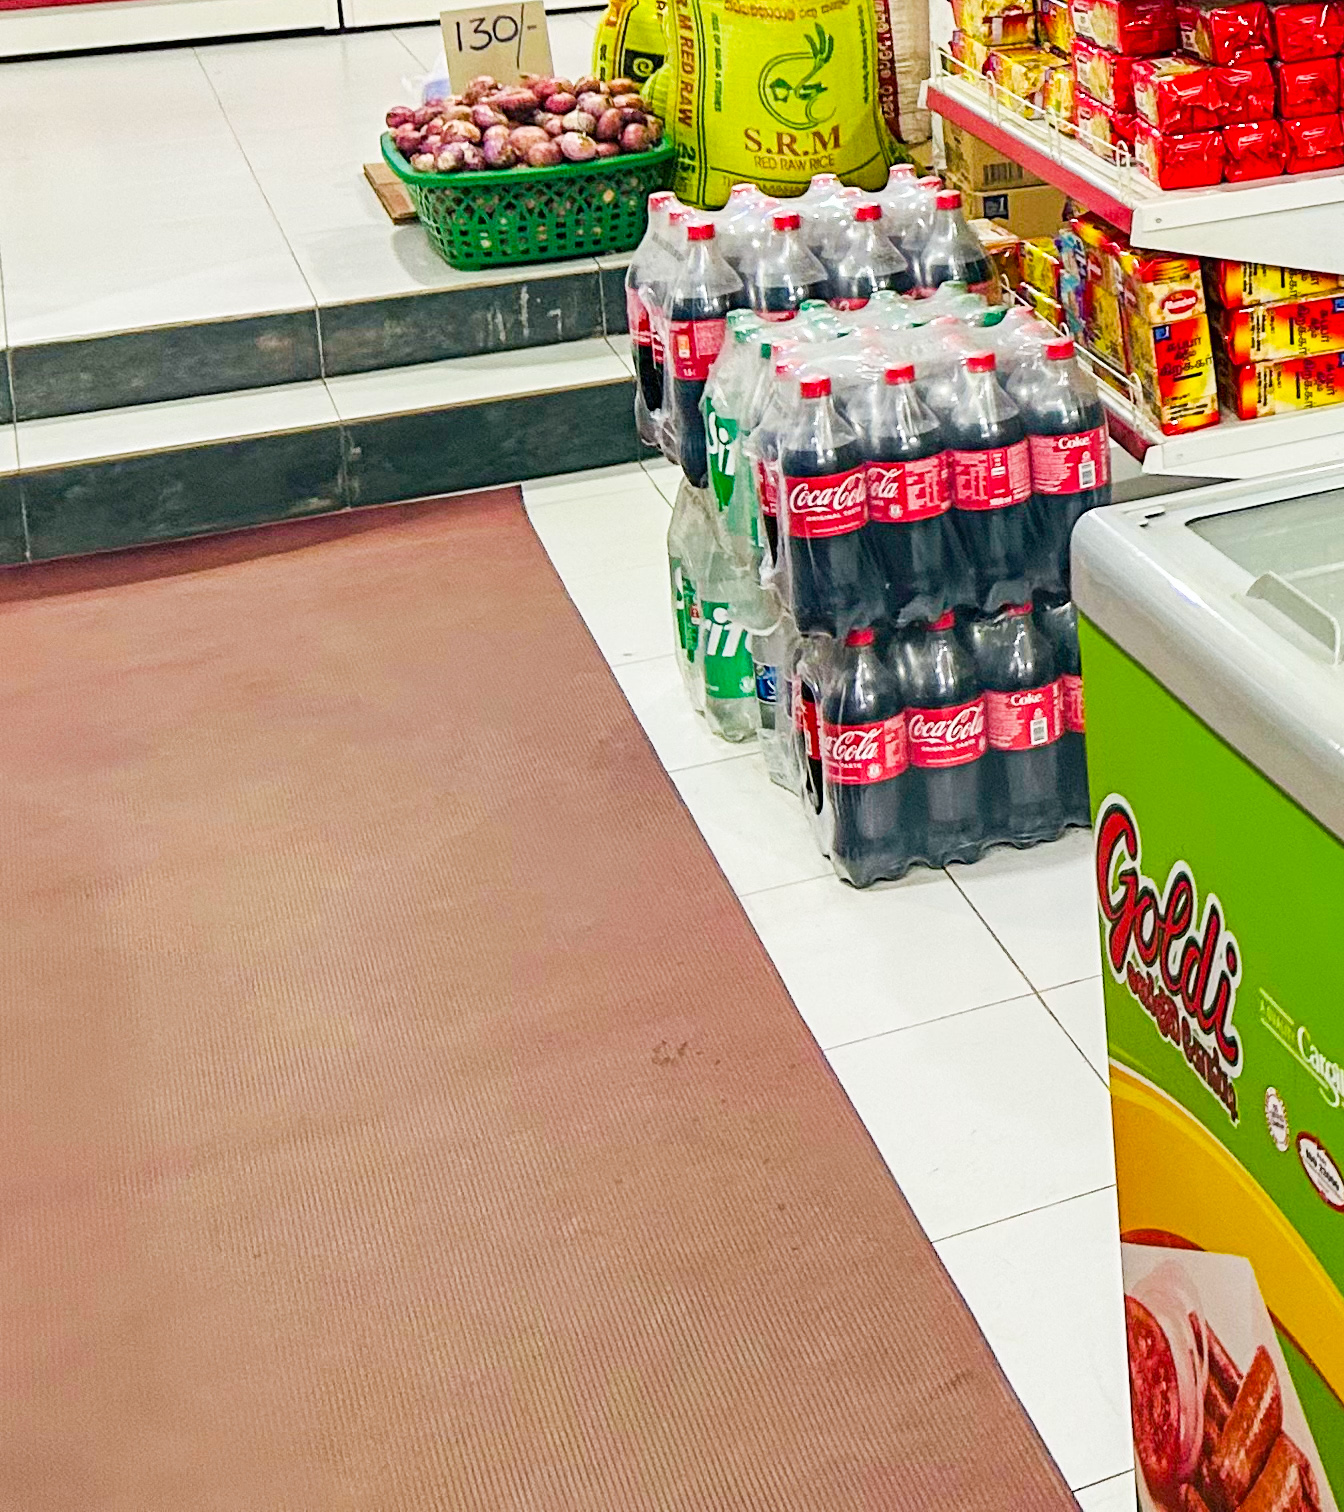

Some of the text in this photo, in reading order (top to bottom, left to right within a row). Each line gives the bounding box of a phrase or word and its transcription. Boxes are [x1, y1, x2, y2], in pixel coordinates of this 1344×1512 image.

[452, 3, 539, 73] 130/-
[744, 124, 841, 157] S.R.M
[754, 154, 835, 171] RED RAW RICE
[1058, 435, 1091, 451] Coke
[1010, 693, 1042, 706] Coke
[1096, 800, 1243, 1068] Goldi
